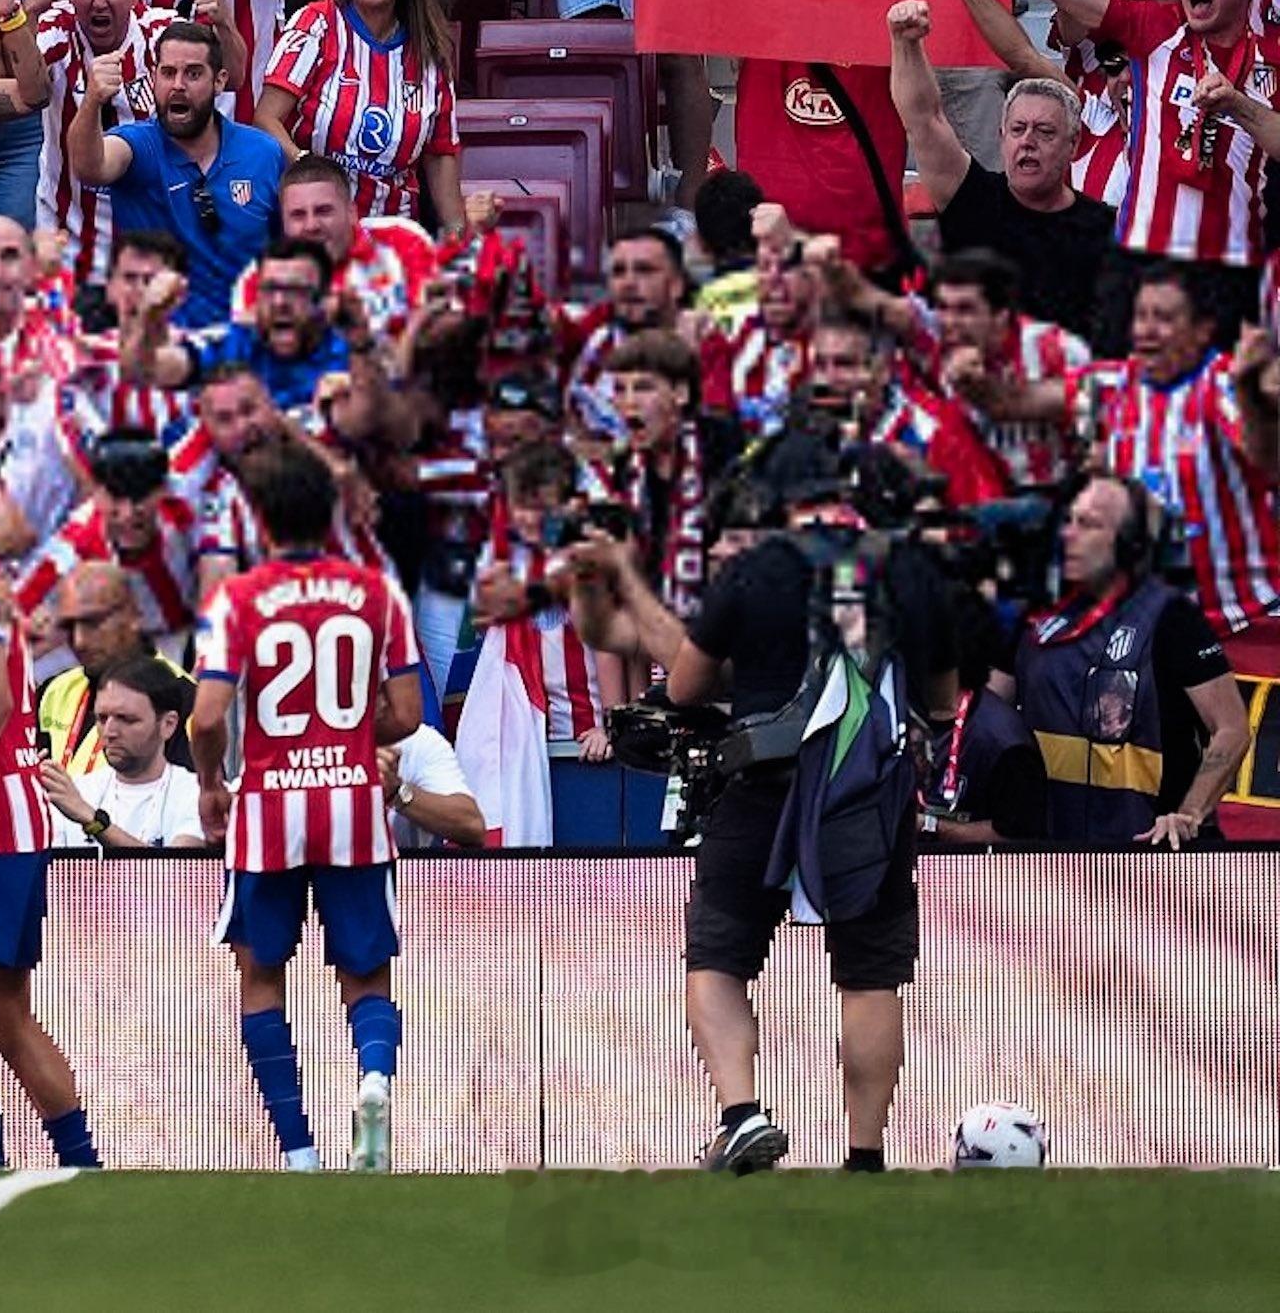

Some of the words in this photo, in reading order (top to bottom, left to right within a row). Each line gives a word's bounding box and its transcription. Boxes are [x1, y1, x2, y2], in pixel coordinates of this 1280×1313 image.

[255, 614, 376, 738] 20
[287, 746, 348, 769] VISIT
[263, 766, 369, 791] RWANDA
